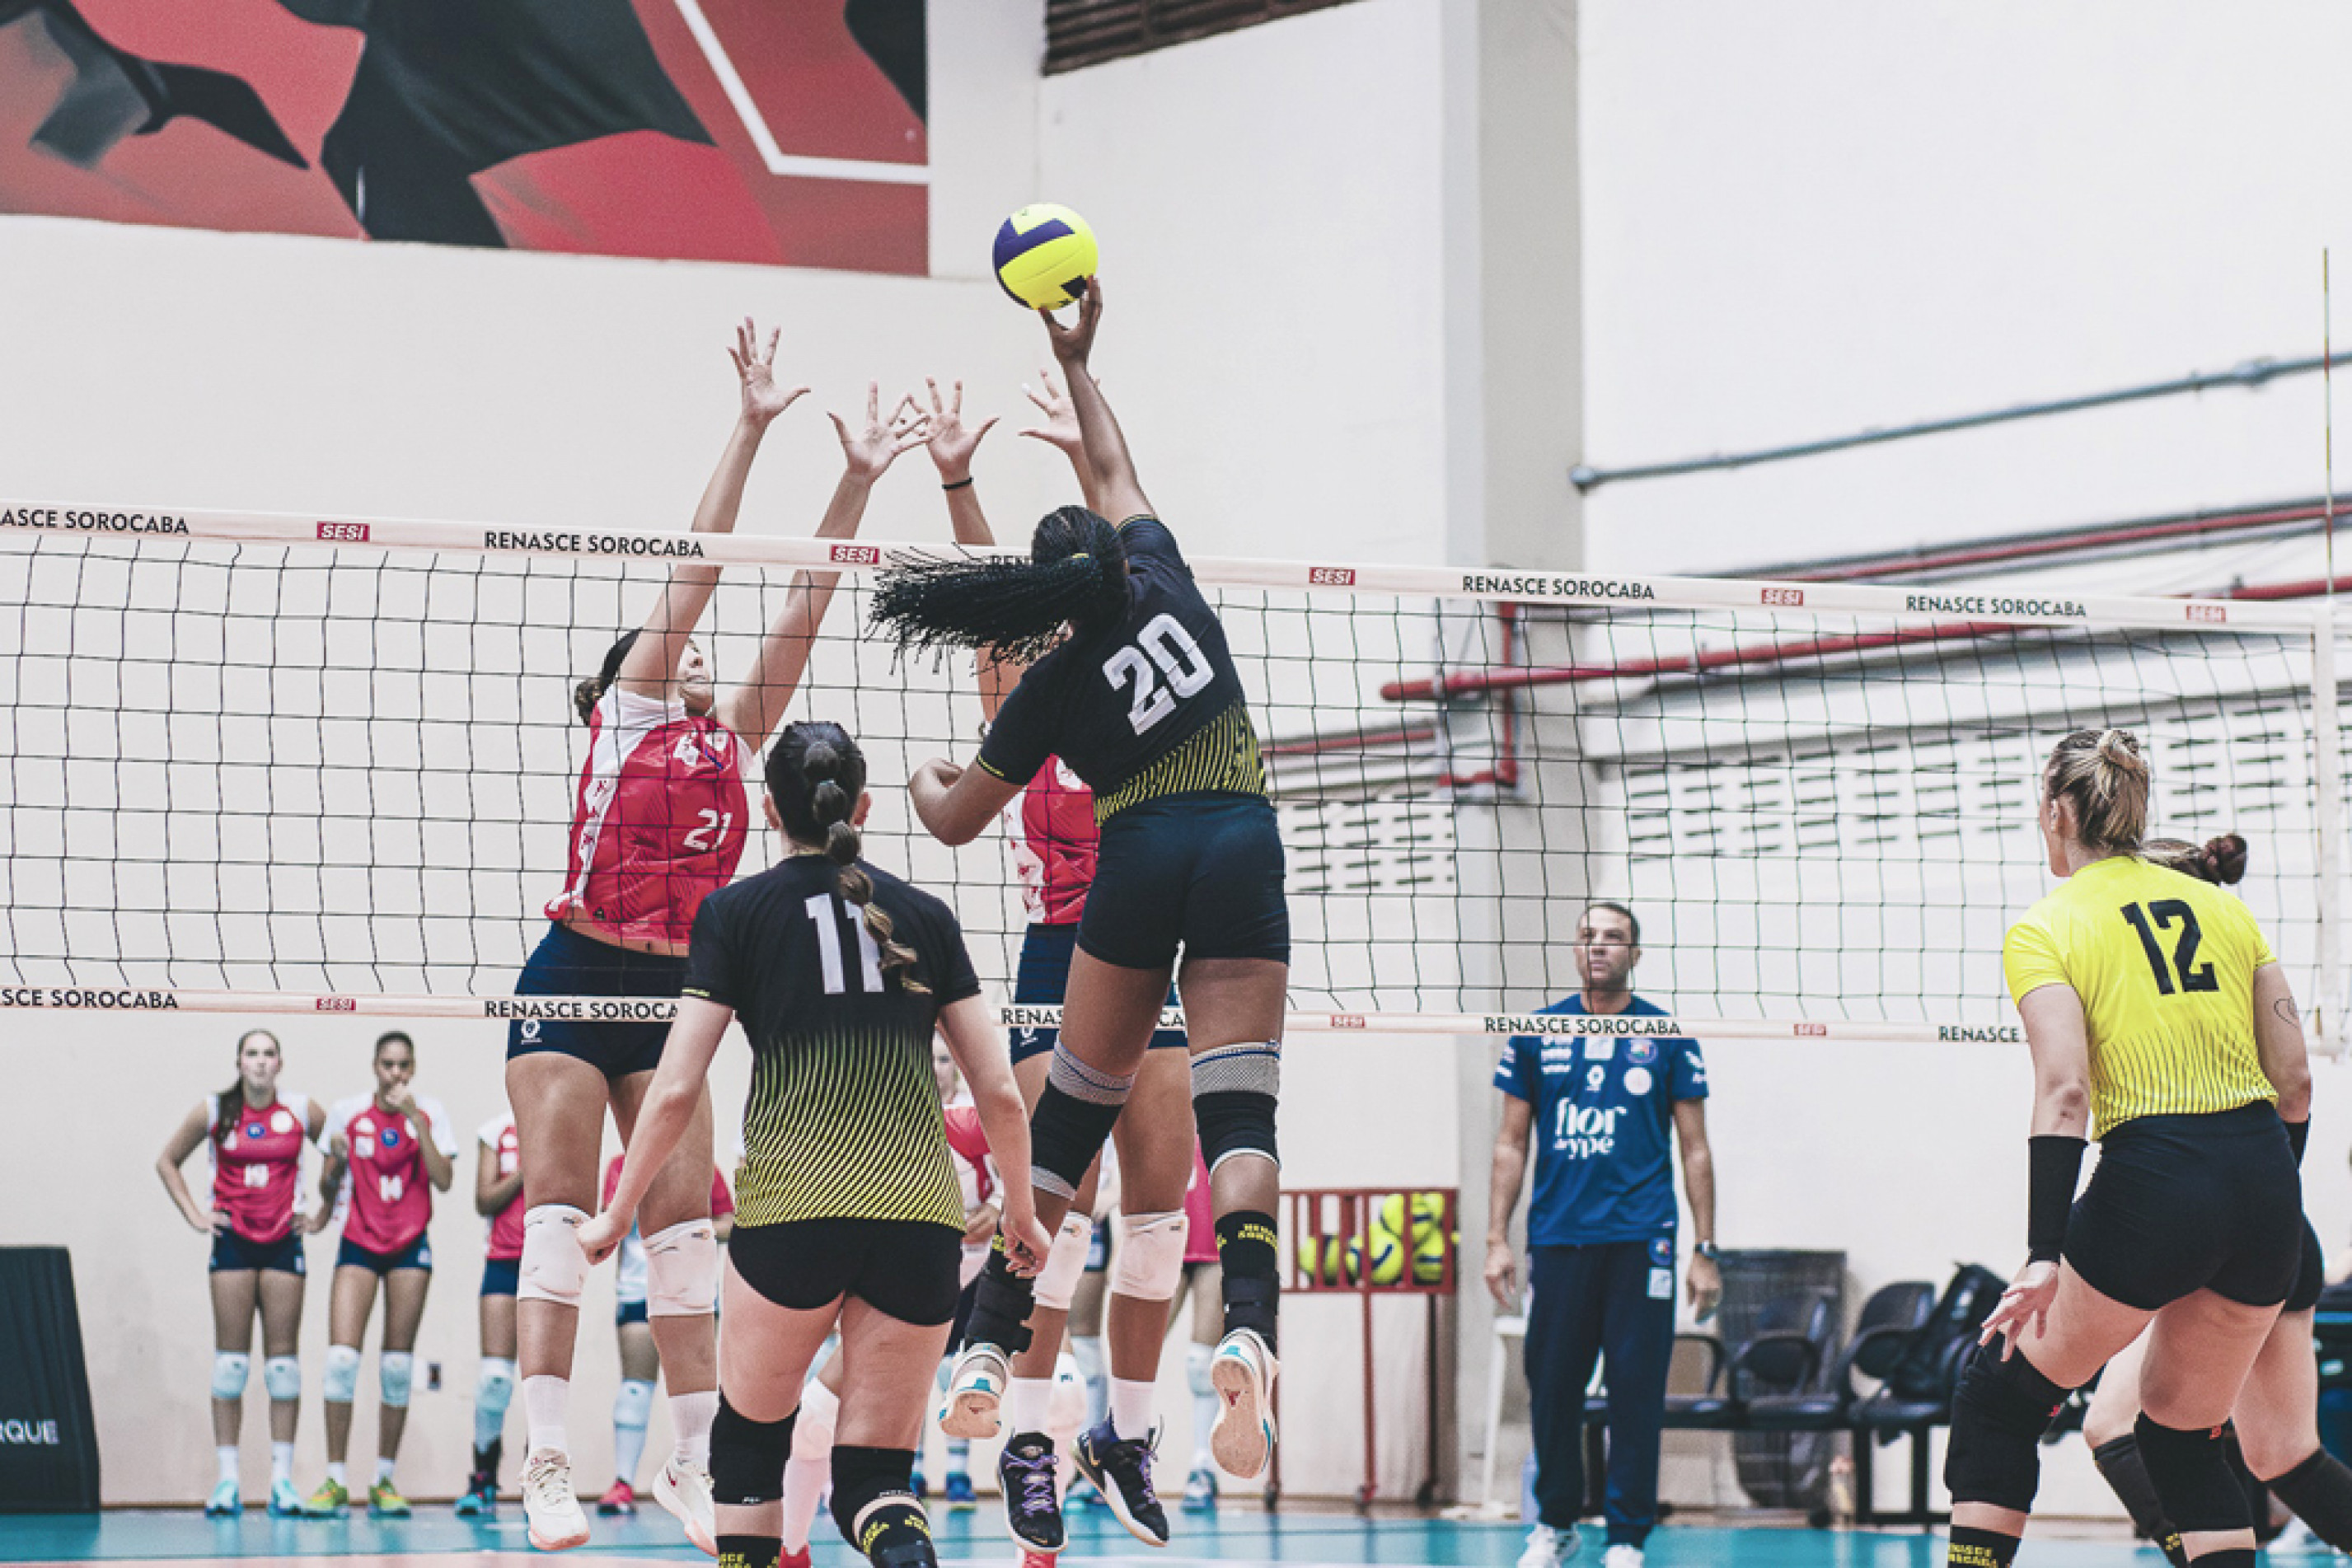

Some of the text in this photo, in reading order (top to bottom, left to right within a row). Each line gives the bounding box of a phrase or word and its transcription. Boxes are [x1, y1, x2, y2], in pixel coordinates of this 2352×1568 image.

[1, 508, 190, 535] ASCE SOROCABA
[321, 523, 366, 541] SESI
[484, 531, 705, 559] RENASCE SOROCABA
[834, 546, 877, 564] SESI
[1313, 568, 1352, 585] SESI
[1462, 575, 1655, 601] RENASCE SOROCABA
[1906, 594, 2087, 617] RENASCE SOROCABA
[1102, 613, 1215, 736] 20
[684, 807, 733, 851] 21
[804, 892, 884, 994] 11
[2120, 898, 2220, 996] 12
[51, 989, 179, 1009] SOROCABA
[485, 1000, 583, 1018] RENASCE
[1484, 1016, 1682, 1036] RENASCE SOROCABA
[1938, 1026, 2020, 1043] RENASCE
